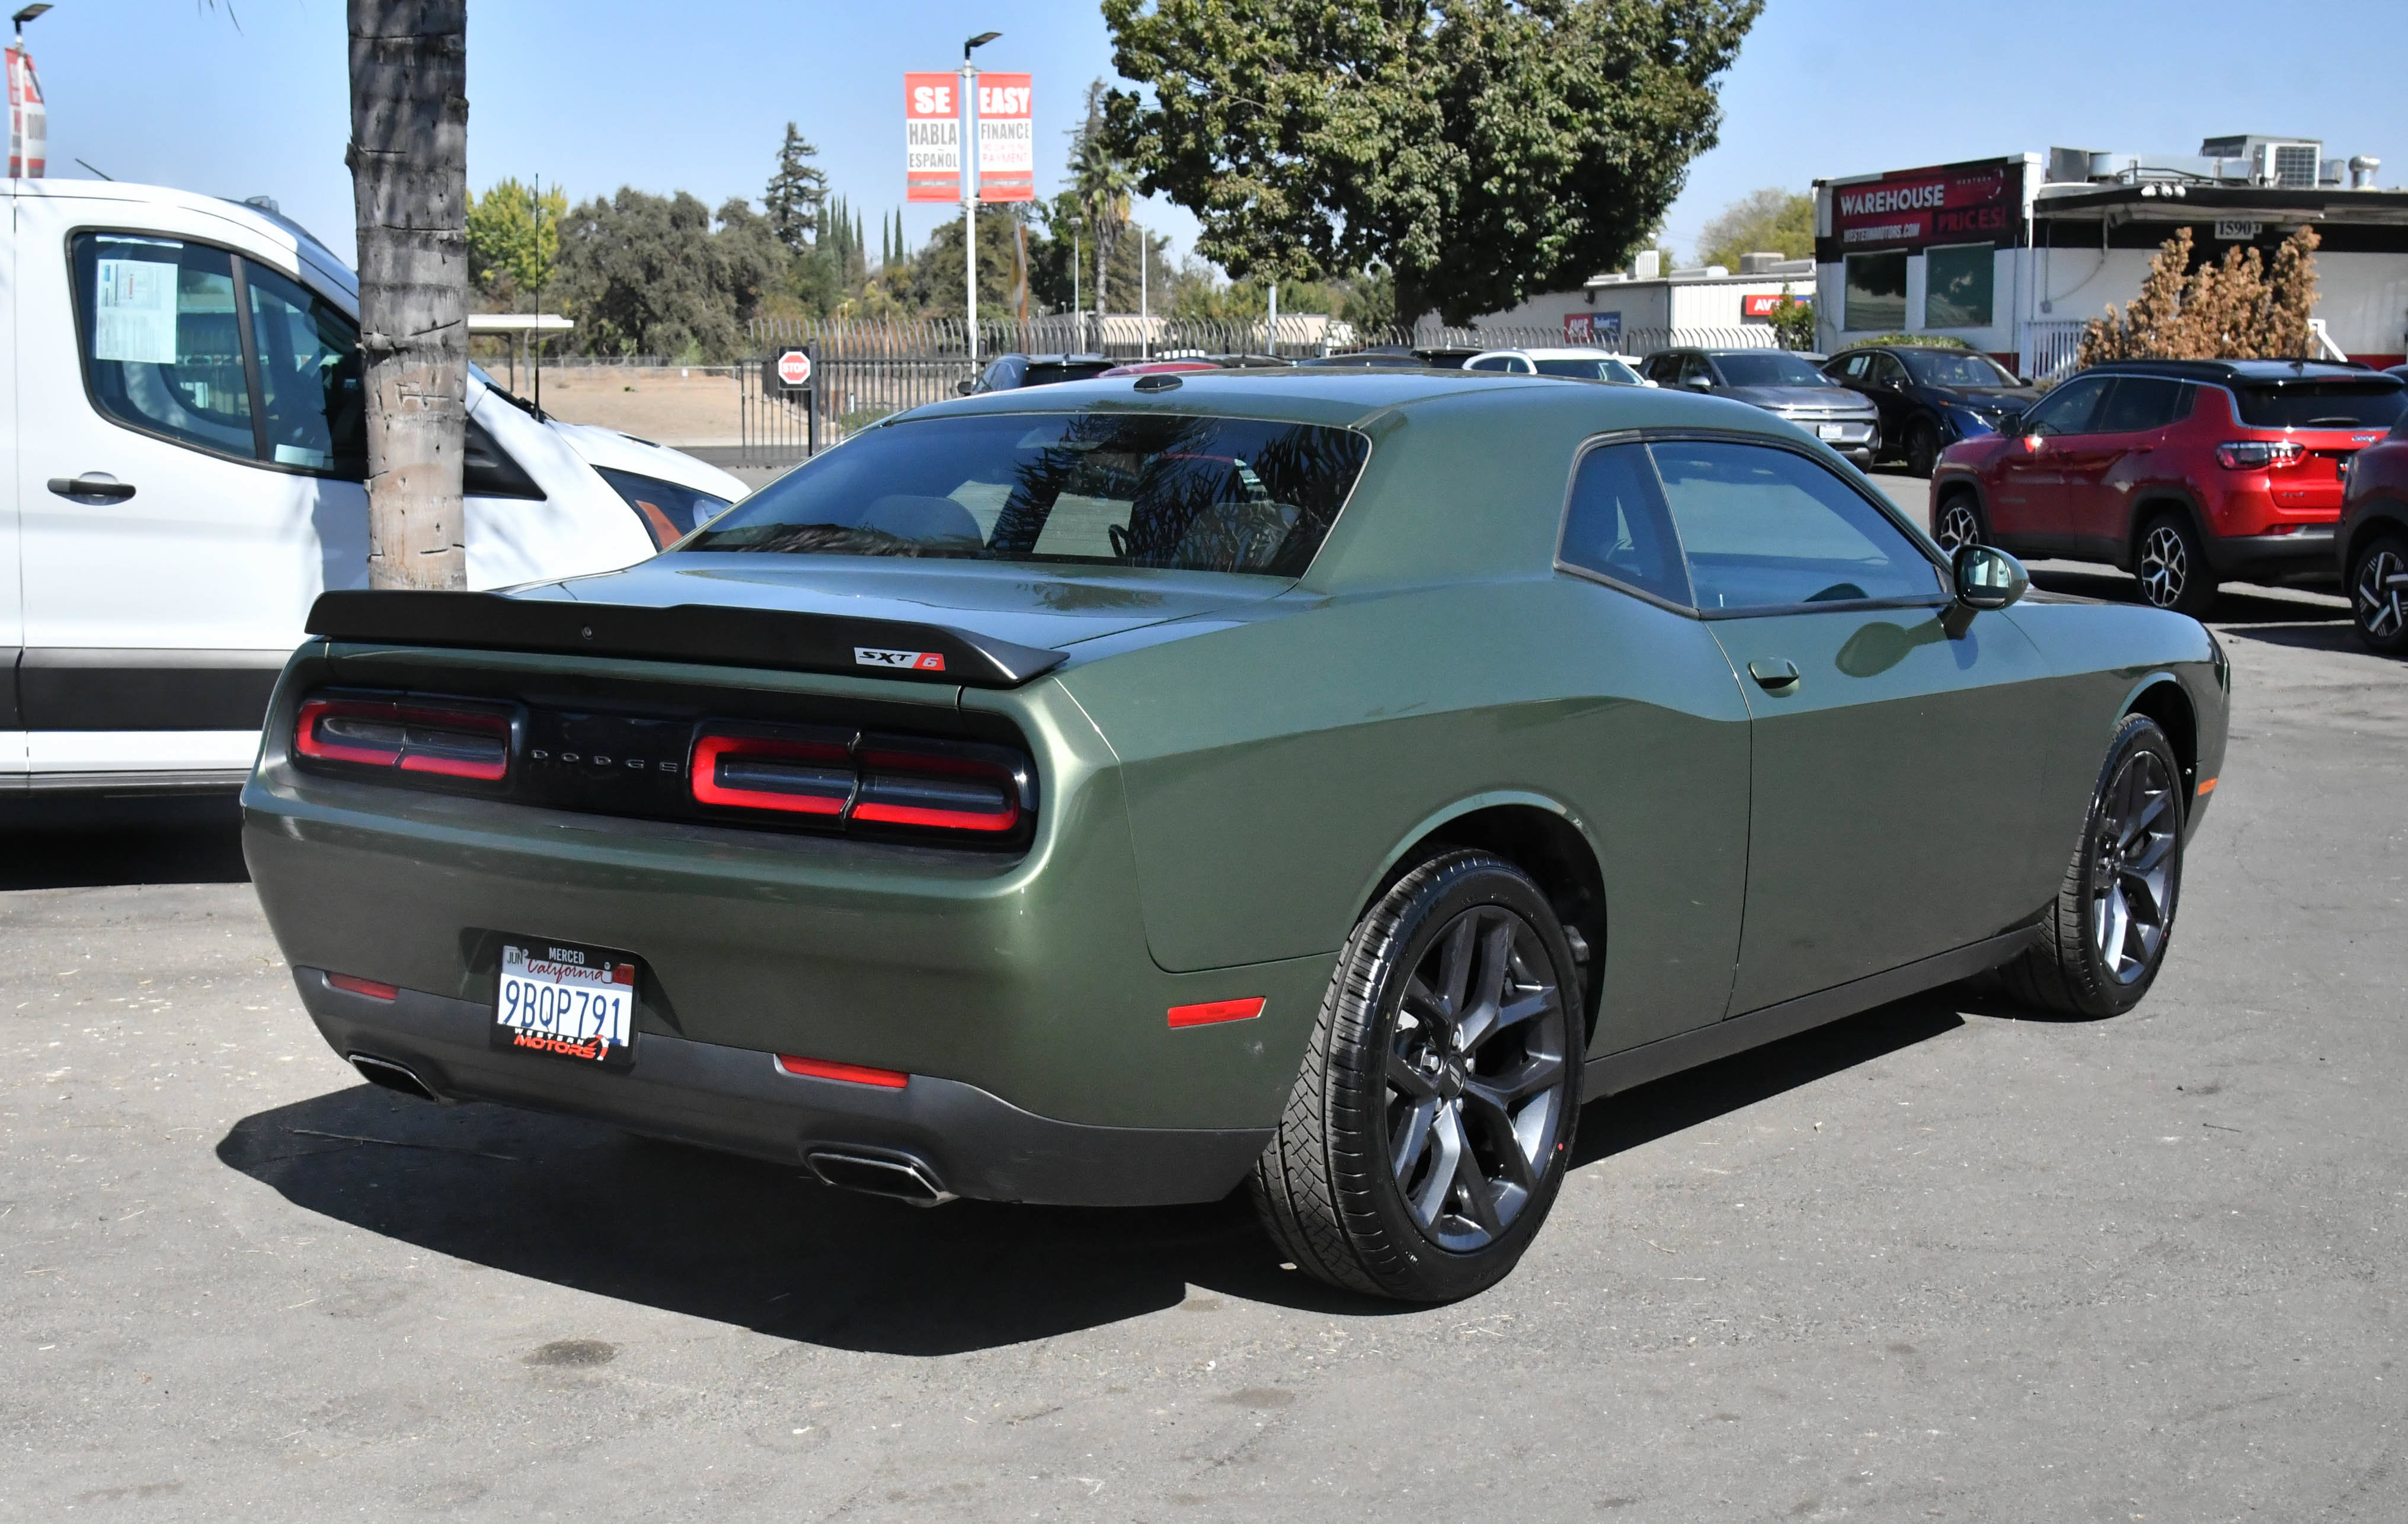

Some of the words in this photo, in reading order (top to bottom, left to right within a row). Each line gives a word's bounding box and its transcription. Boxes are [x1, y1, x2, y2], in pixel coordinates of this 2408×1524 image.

[914, 87, 951, 114] SE
[979, 87, 1030, 114] EASY
[909, 123, 957, 145] HABLA
[981, 123, 1029, 139] FINANCE
[909, 148, 957, 168] ESPAÑOL
[1840, 184, 1945, 218] WAREHOUSE
[1938, 206, 2007, 232] PRICES!
[2218, 221, 2252, 235] 1590
[782, 362, 807, 373] STOP
[859, 651, 912, 664] SXT
[922, 657, 939, 667] 6
[531, 749, 678, 772] DODGE
[507, 950, 523, 965] JUN
[549, 947, 584, 965] MERCED
[527, 958, 613, 985] California
[503, 980, 623, 1044] 9BQP791
[513, 1034, 597, 1059] MOTORS
[514, 1027, 585, 1046] WESTERN
